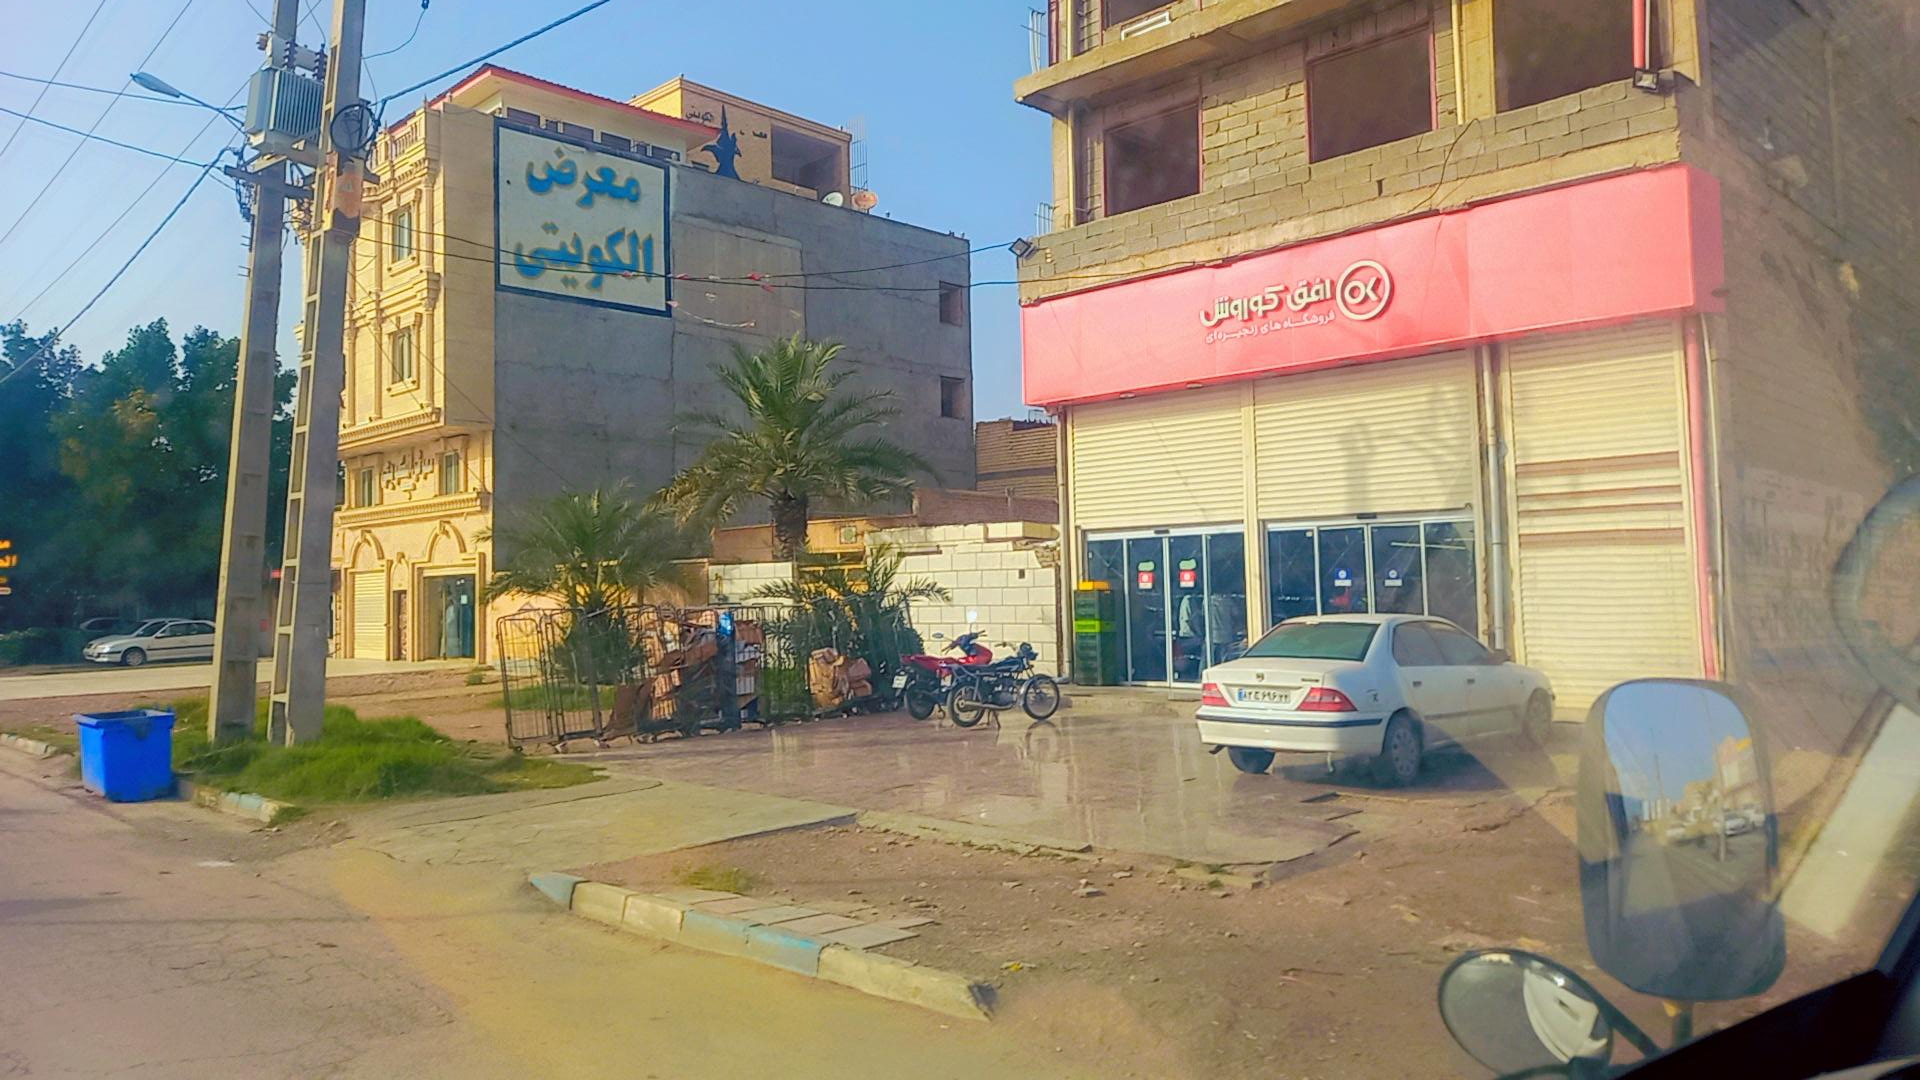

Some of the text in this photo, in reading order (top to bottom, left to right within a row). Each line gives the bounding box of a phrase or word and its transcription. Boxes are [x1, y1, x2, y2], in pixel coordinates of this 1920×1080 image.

[526, 147, 641, 209] معرض
[1199, 277, 1333, 327] افق کوروش
[1260, 318, 1281, 335] های
[1283, 310, 1336, 329] فروشگاه
